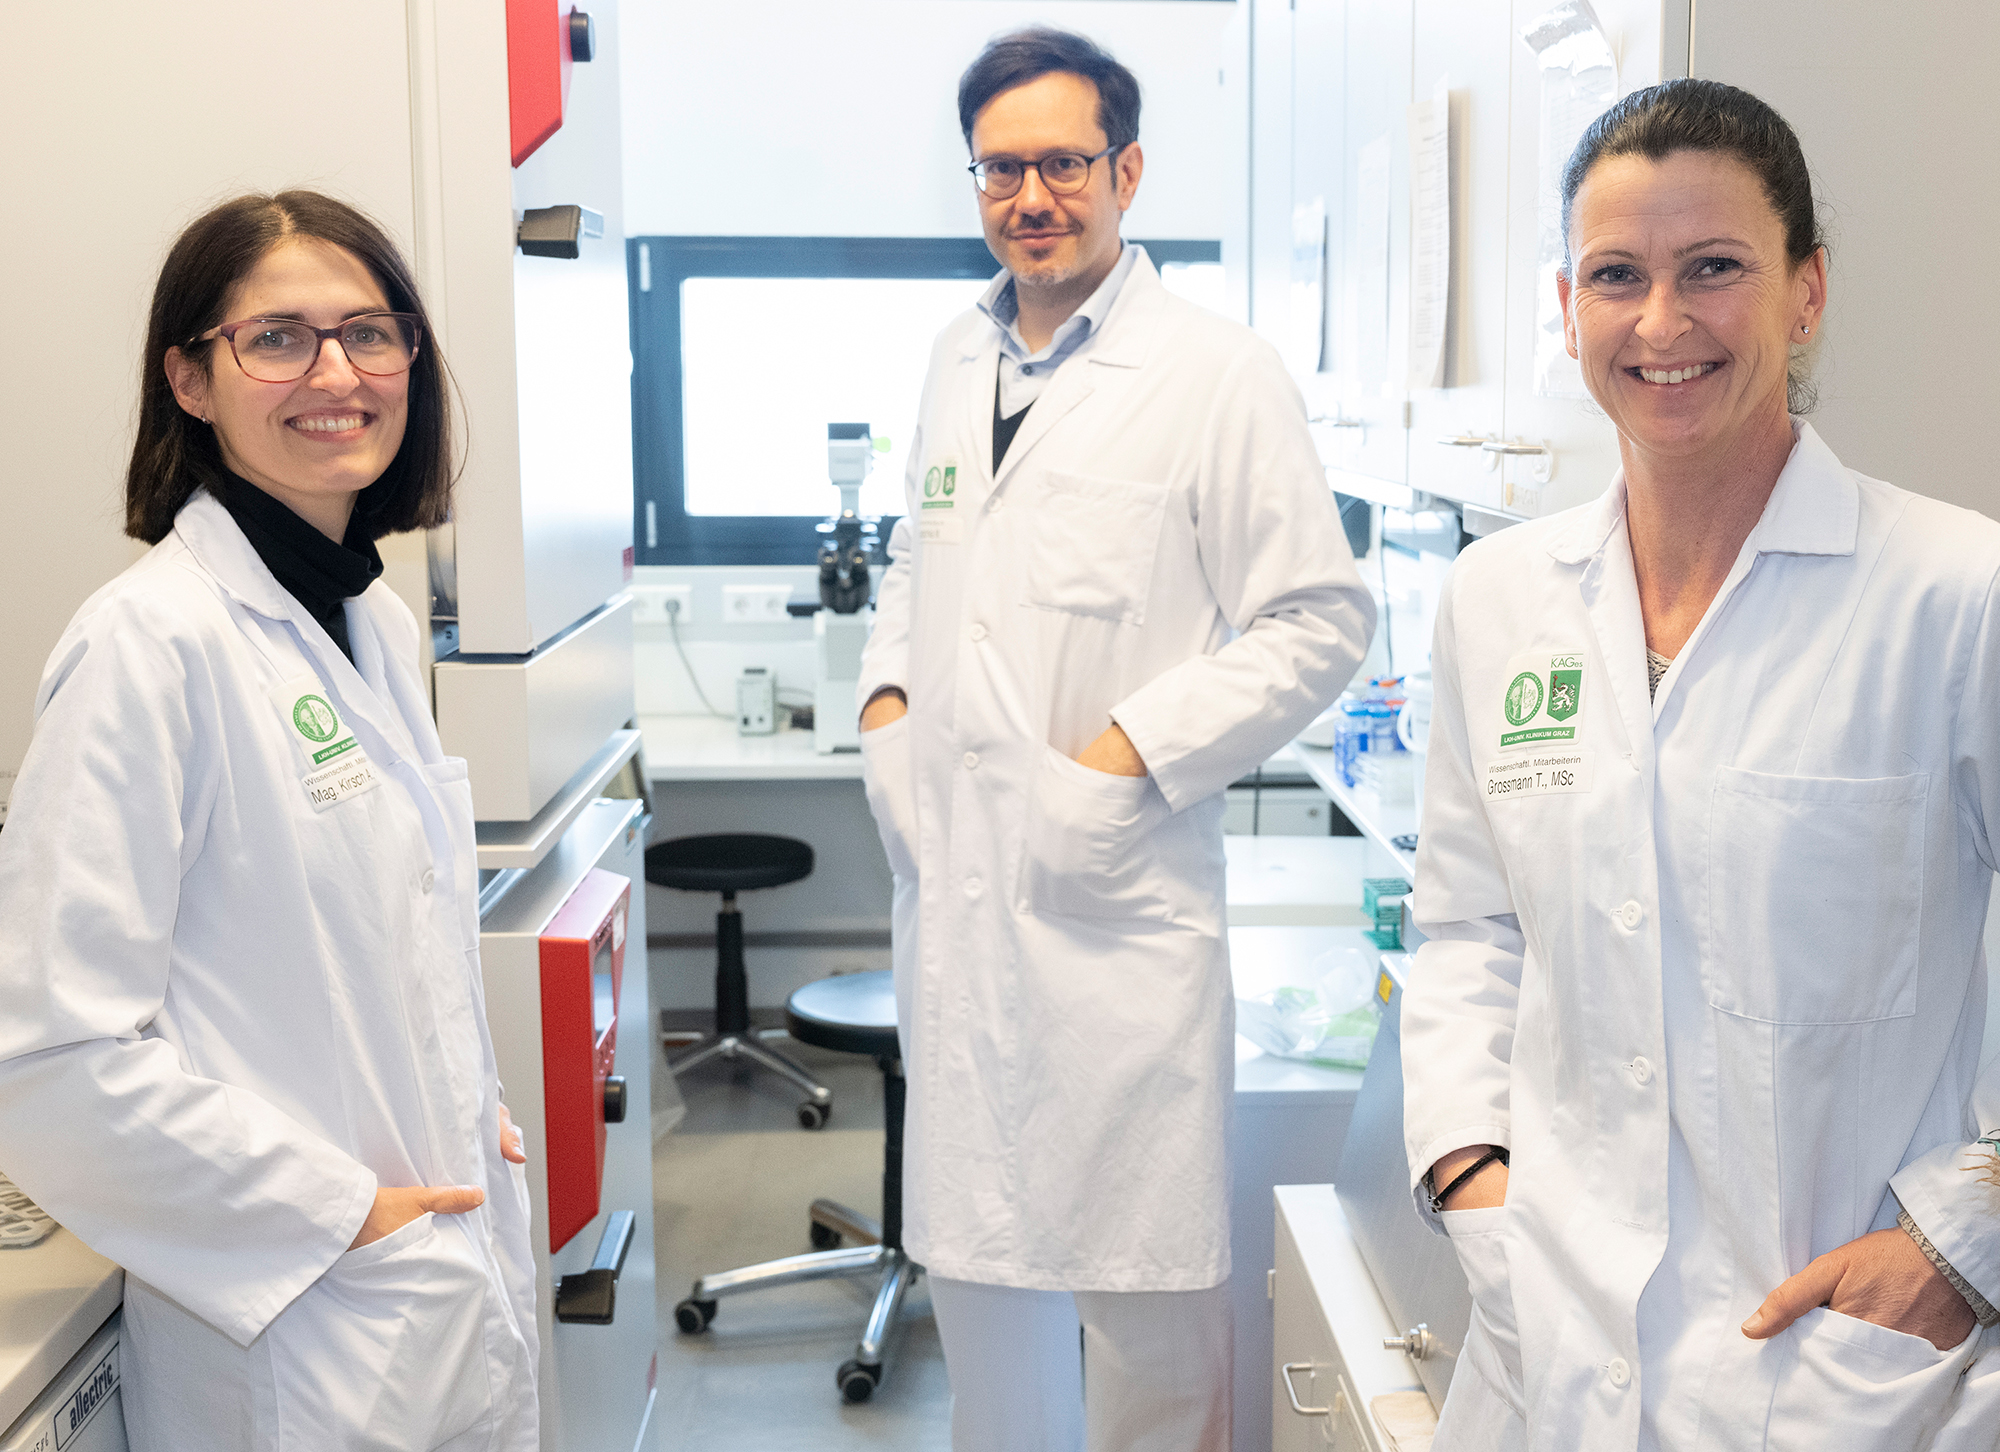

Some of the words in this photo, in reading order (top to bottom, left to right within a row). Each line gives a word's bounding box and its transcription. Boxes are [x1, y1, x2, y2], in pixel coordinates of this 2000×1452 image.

[1551, 657, 1583, 668] KAGes
[1525, 731, 1551, 739] KLINIKUM
[1533, 756, 1581, 767] Mitarbeiterin
[311, 786, 339, 804] Mag.
[338, 772, 365, 792] Kirsch
[1487, 776, 1533, 795] Grossmann
[1536, 772, 1548, 790] T.,
[1551, 770, 1574, 786] MSc
[69, 1362, 113, 1431] allectric
